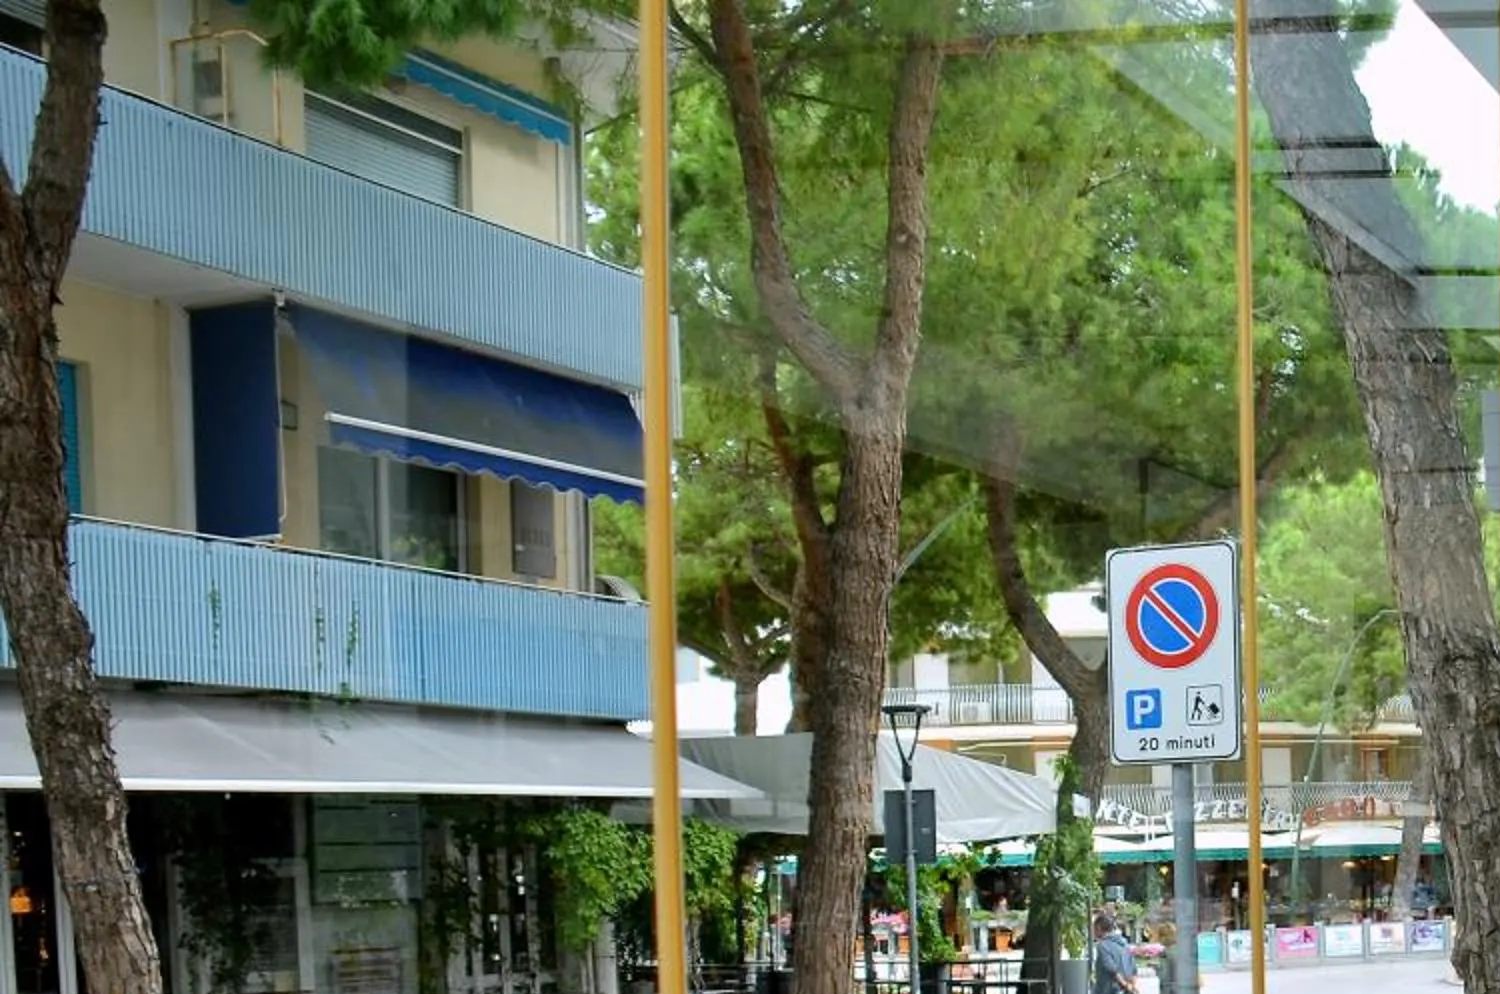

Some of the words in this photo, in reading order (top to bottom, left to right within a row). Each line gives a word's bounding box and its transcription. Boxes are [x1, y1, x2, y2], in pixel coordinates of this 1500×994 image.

[1133, 695, 1155, 725] P
[1139, 737, 1159, 751] 20
[1166, 733, 1216, 751] minuti
